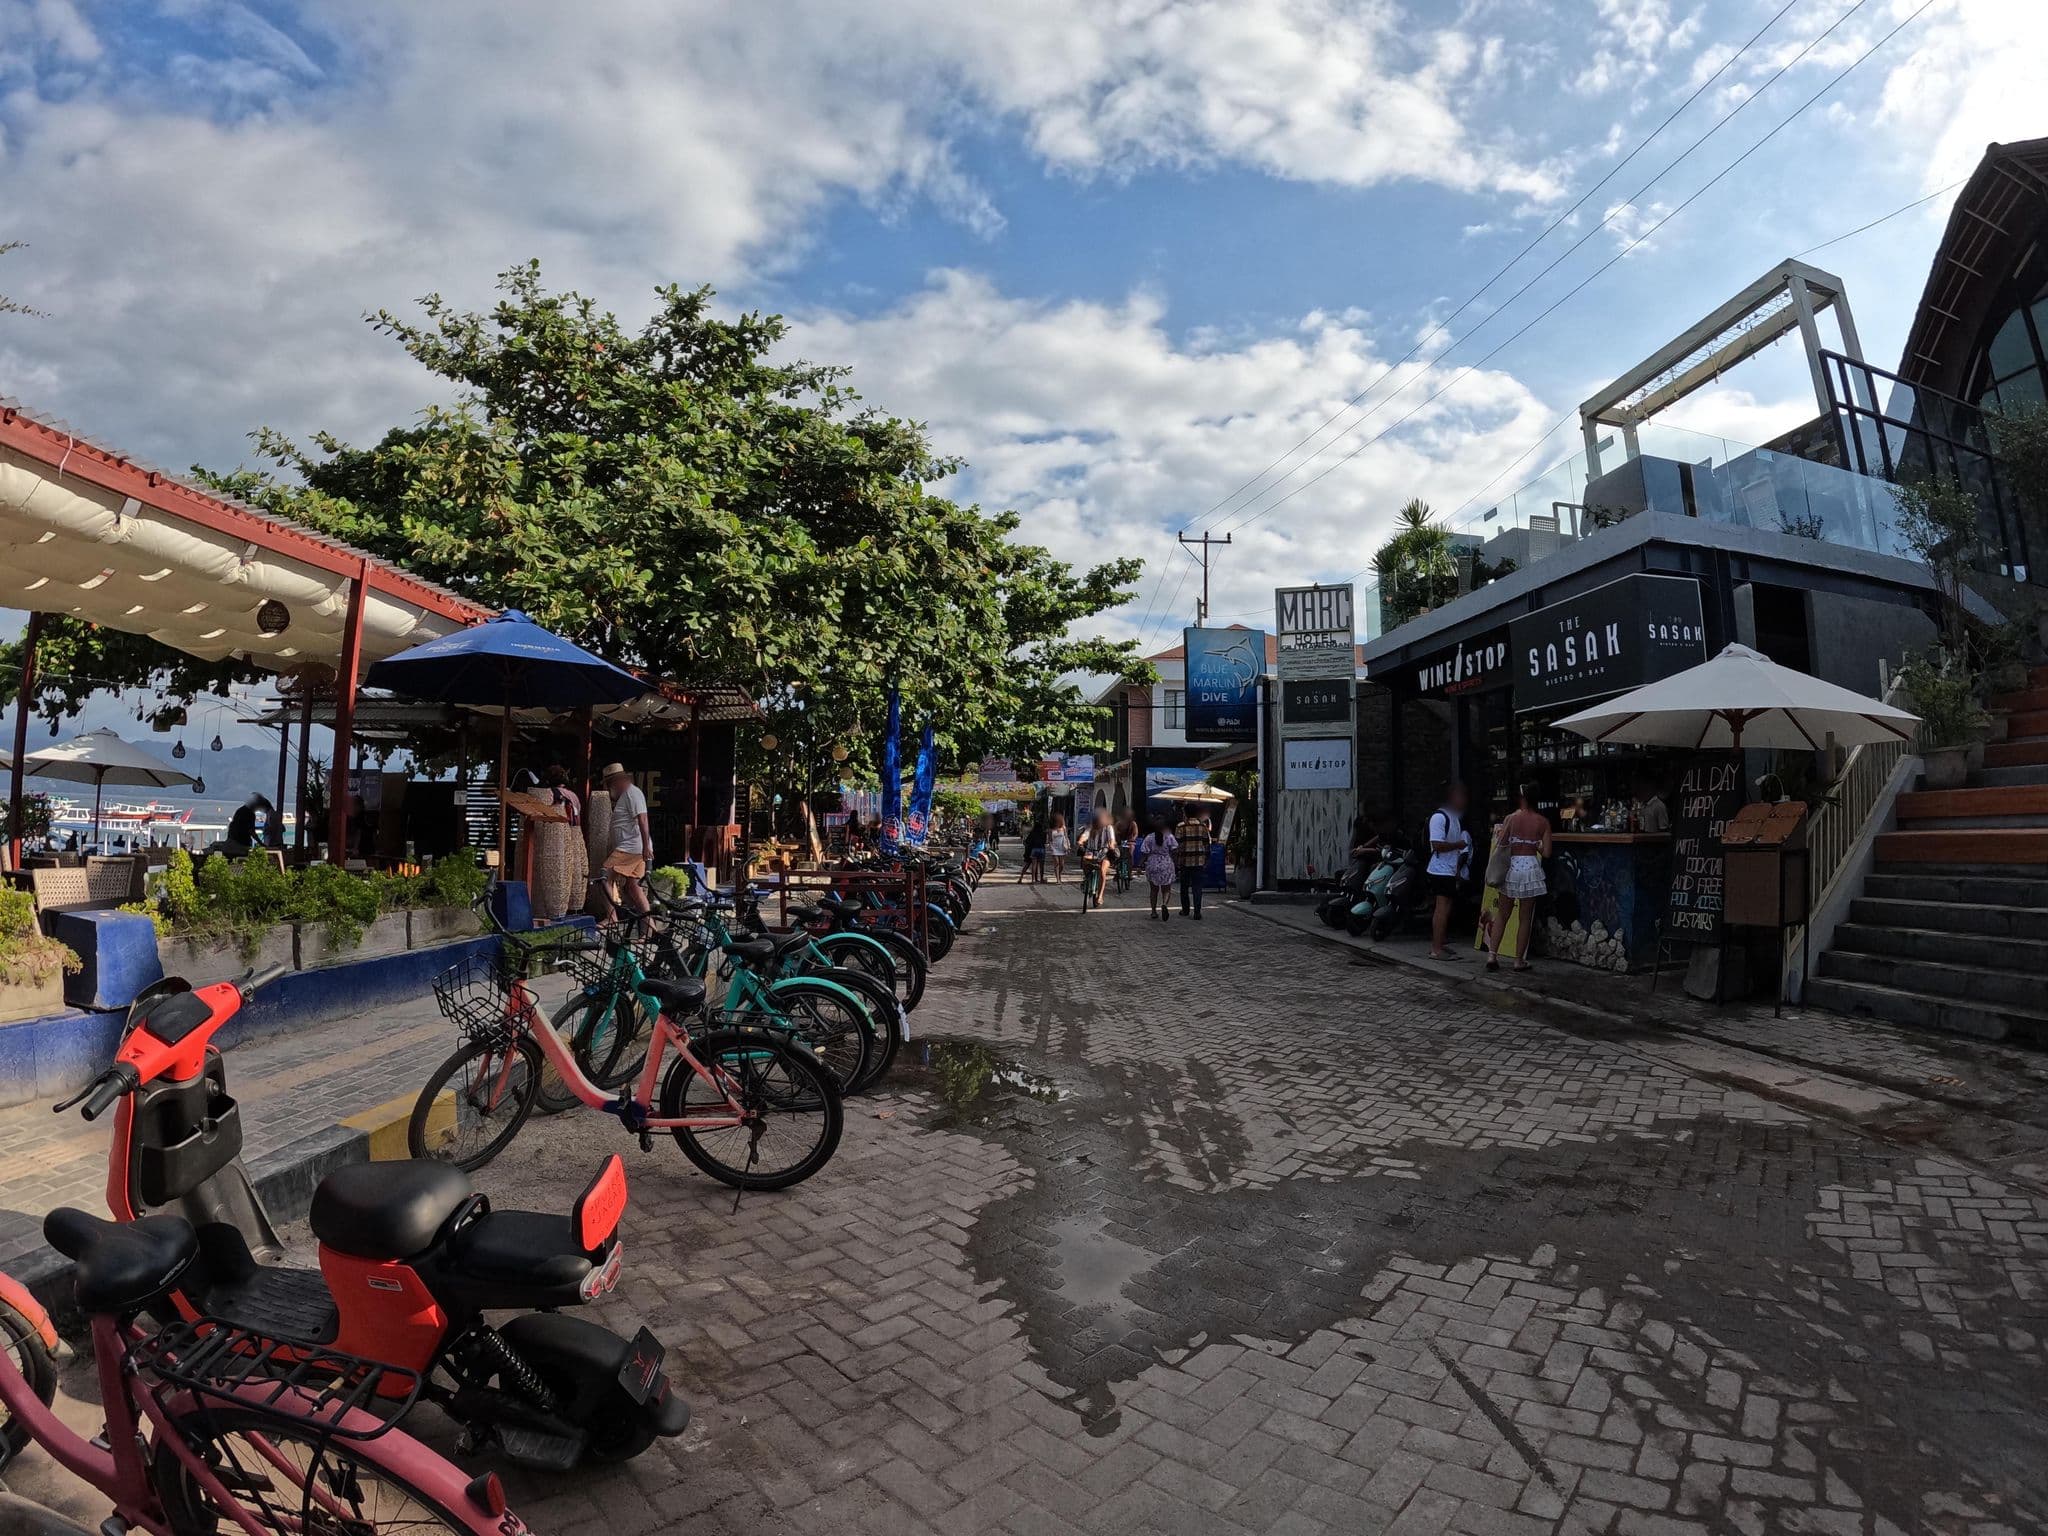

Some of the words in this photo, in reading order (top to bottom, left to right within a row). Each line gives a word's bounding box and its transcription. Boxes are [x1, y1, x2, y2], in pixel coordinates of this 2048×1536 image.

[1280, 588, 1350, 631] MARC
[1559, 616, 1581, 633] THE
[1648, 623, 1702, 641] SASAK
[1295, 632, 1336, 645] HOTEL
[1529, 622, 1621, 677] SASAK
[1201, 663, 1228, 674] BLUE
[1419, 660, 1452, 691] WINE
[1466, 643, 1505, 676] STOP
[1193, 678, 1236, 688] MARLIN
[1545, 674, 1575, 686] BISTRO
[1588, 667, 1605, 676] BAR
[1201, 691, 1228, 702] DIVE
[1296, 694, 1337, 705] SASAK
[1290, 760, 1313, 769] WINE
[1322, 760, 1346, 768] STOP
[1680, 768, 1703, 793] ALL
[1709, 763, 1741, 791] DAY
[1682, 794, 1721, 818] HAPPY
[1675, 838, 1700, 856] WITH
[1672, 874, 1695, 890] AND
[1697, 877, 1723, 895] FREE
[1670, 892, 1690, 906] POOL
